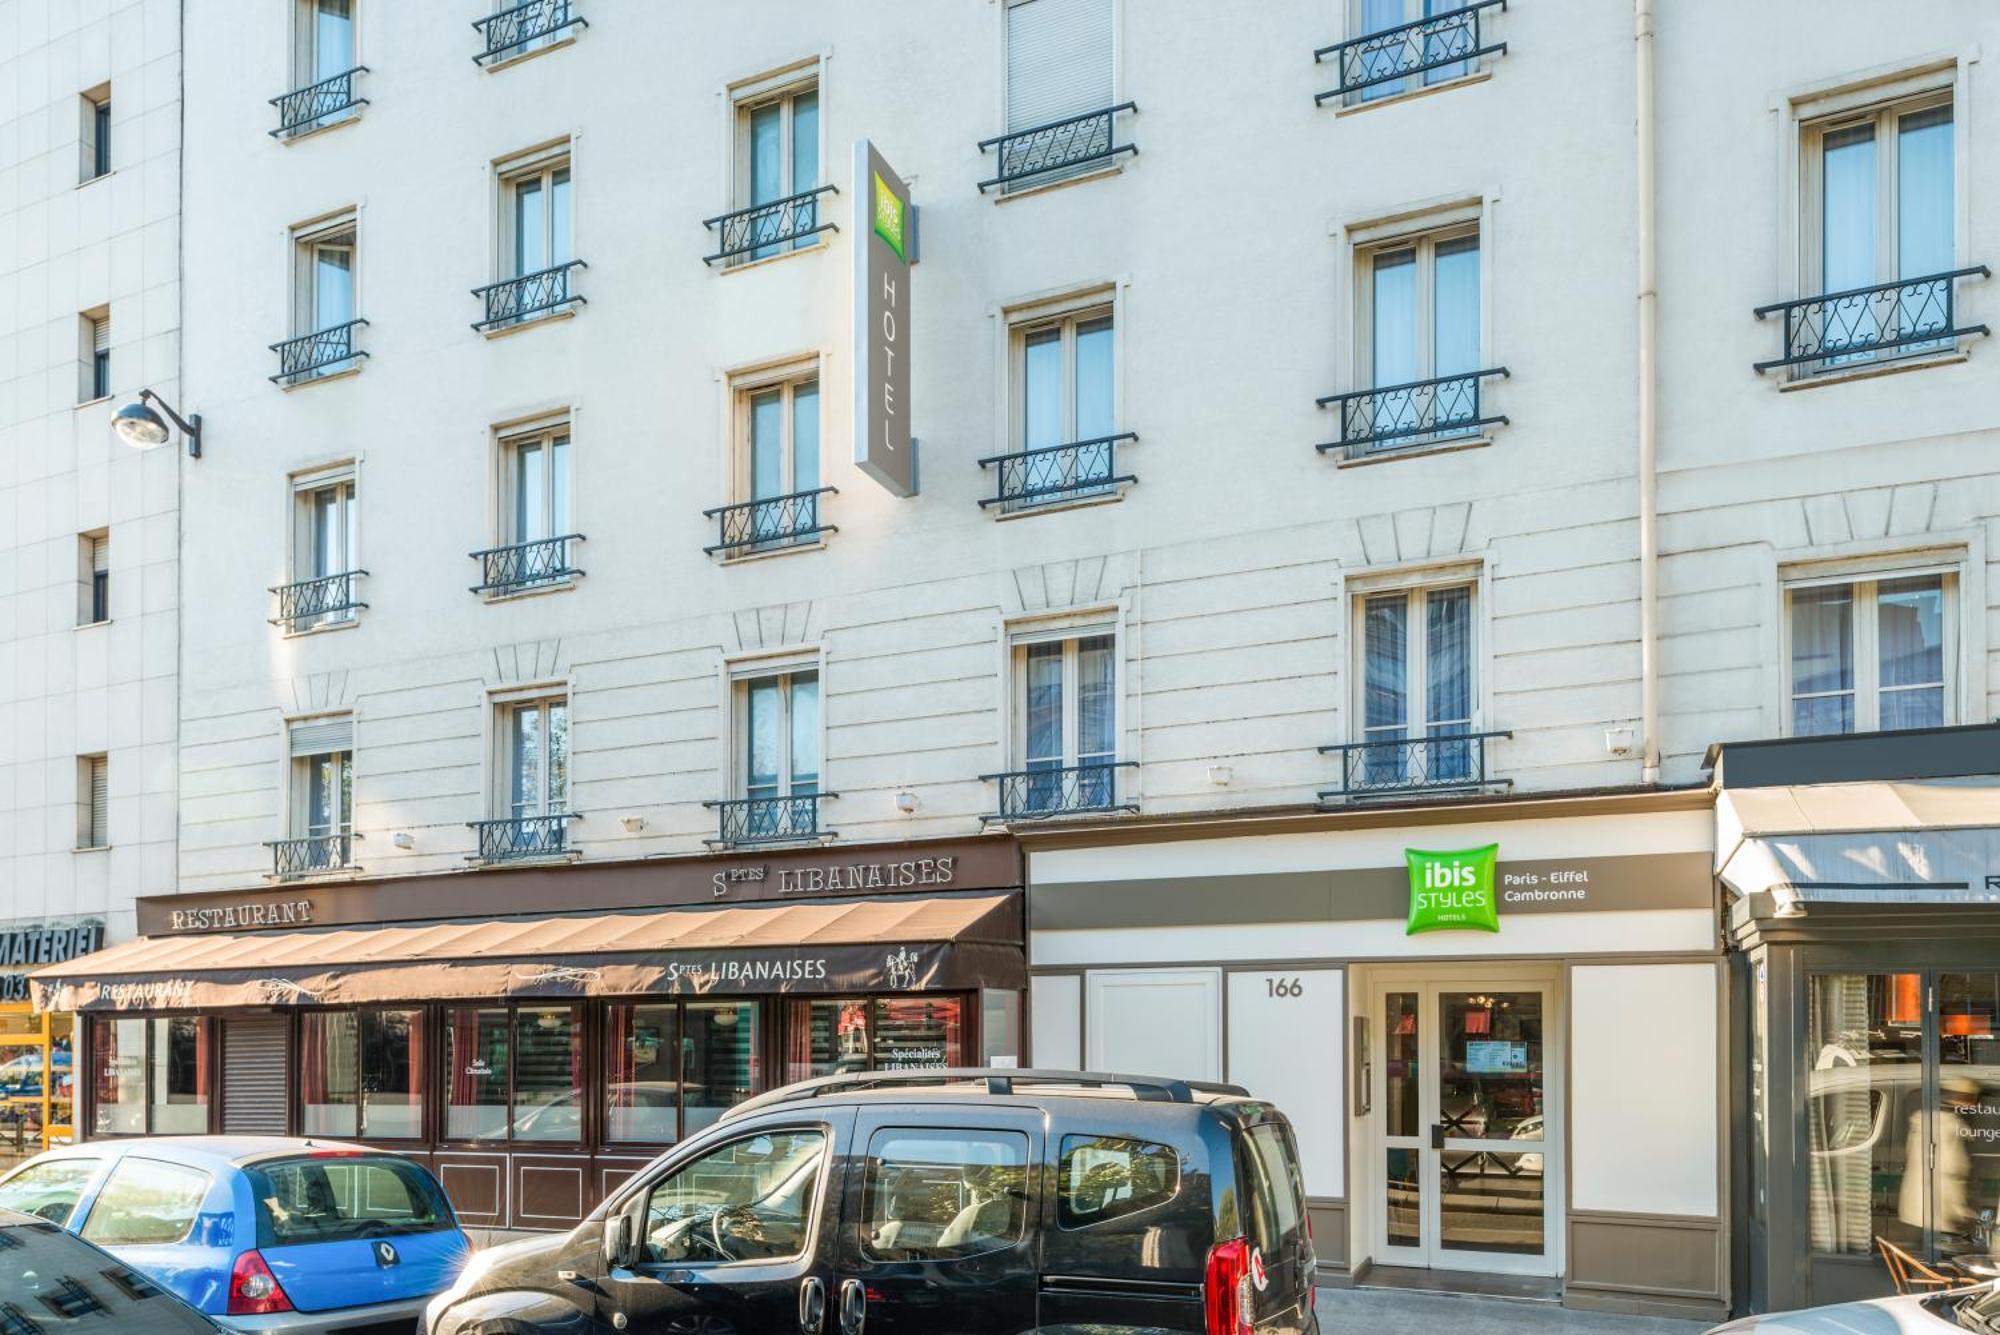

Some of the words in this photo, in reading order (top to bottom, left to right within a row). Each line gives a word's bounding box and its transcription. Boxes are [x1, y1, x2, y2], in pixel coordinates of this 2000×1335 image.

[883, 272, 896, 451] HOTEL
[778, 857, 954, 892] LIBANAISES
[1425, 861, 1476, 888] ibis
[1504, 873, 1538, 885] Paris
[1550, 871, 1588, 883] Eiffel
[1504, 889, 1586, 902] Cambronne
[172, 901, 310, 930] RESTAURANT
[1438, 914, 1466, 922] HOTELS
[711, 959, 826, 980] LIBANAISES
[101, 979, 196, 1000] RESTAURANT
[1265, 978, 1303, 998] 166
[892, 1046, 941, 1062] Spécialités
